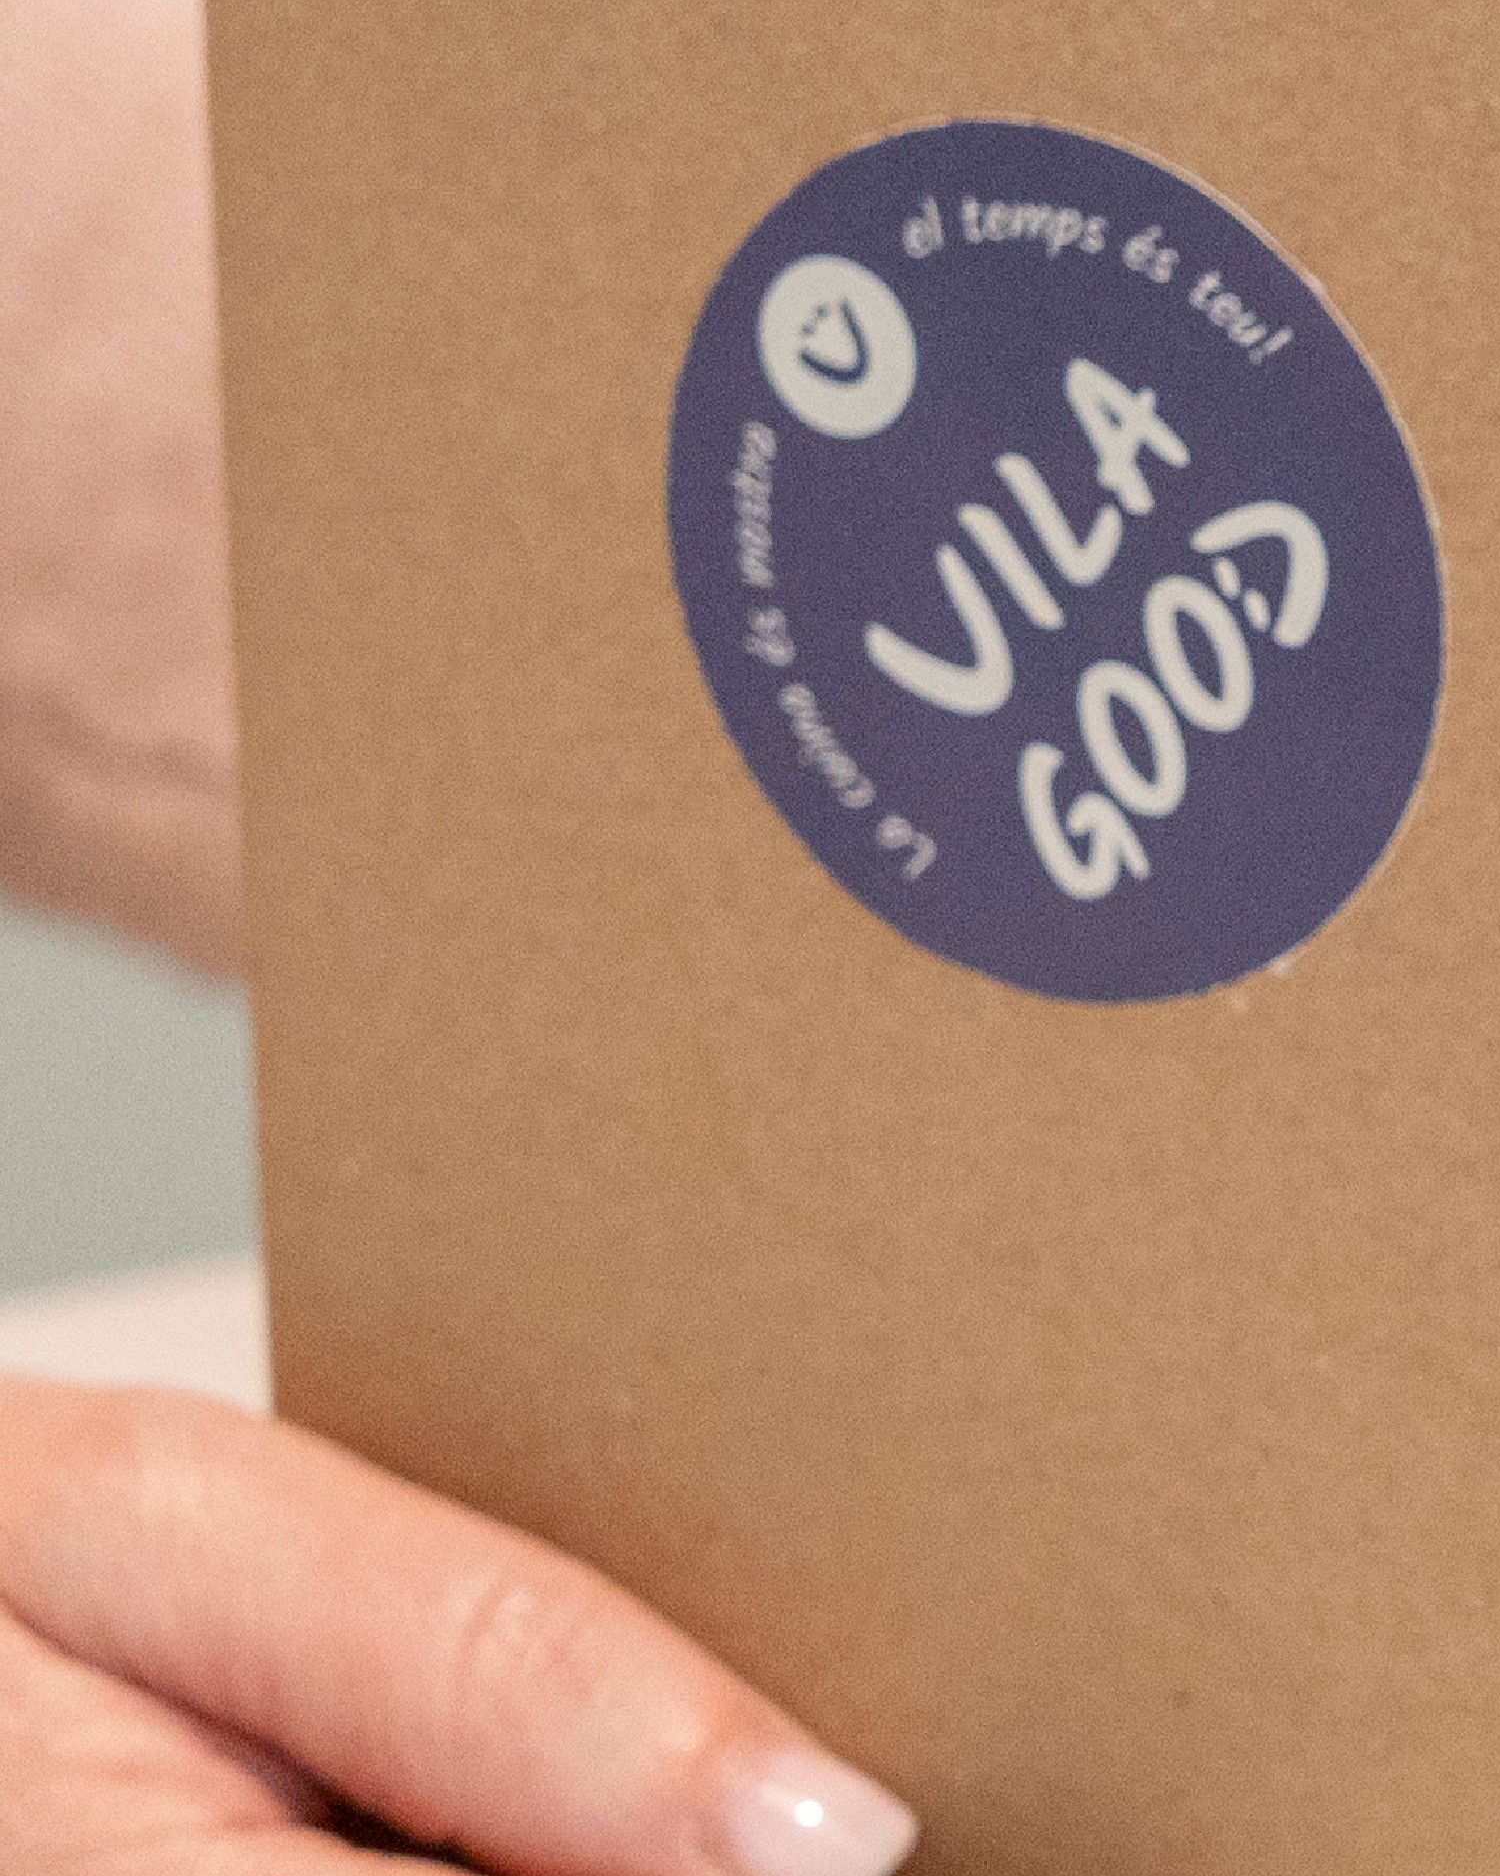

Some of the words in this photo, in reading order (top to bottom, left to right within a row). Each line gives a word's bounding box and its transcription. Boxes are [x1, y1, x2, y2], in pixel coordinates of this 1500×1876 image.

[901, 193, 946, 260] el
[959, 193, 1108, 259] temps
[1122, 224, 1180, 285] és
[862, 356, 1191, 717] VILA
